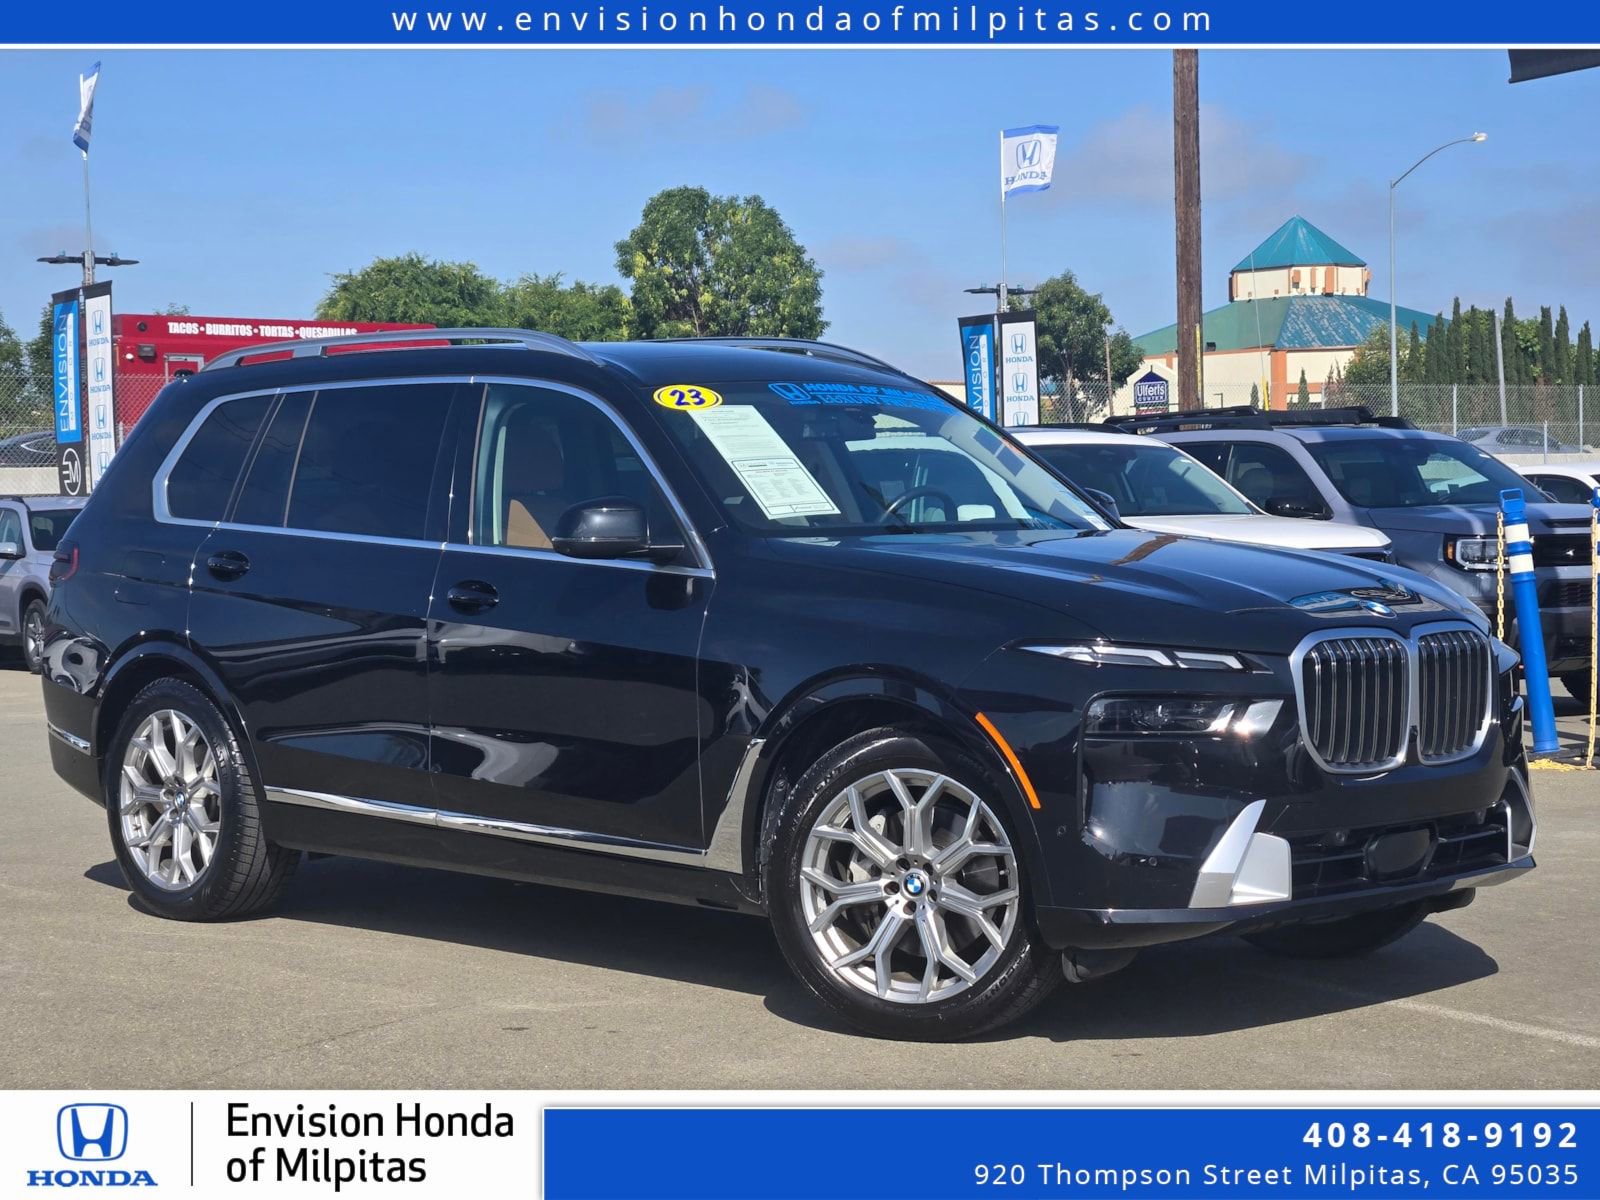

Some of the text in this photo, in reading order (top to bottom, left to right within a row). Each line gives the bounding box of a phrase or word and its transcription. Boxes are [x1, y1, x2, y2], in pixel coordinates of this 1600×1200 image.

[168, 322, 199, 334] TACOS
[206, 323, 253, 336] BURRITOS
[259, 325, 294, 338] TORTAS
[88, 336, 110, 347] HONDA
[1005, 355, 1034, 364] HONDA
[59, 313, 69, 432] ENVISION
[90, 384, 111, 394] HONDA
[803, 383, 860, 392] HONDA
[669, 388, 706, 406] 23
[1006, 395, 1035, 403] HONDA
[92, 431, 112, 441] HONDA
